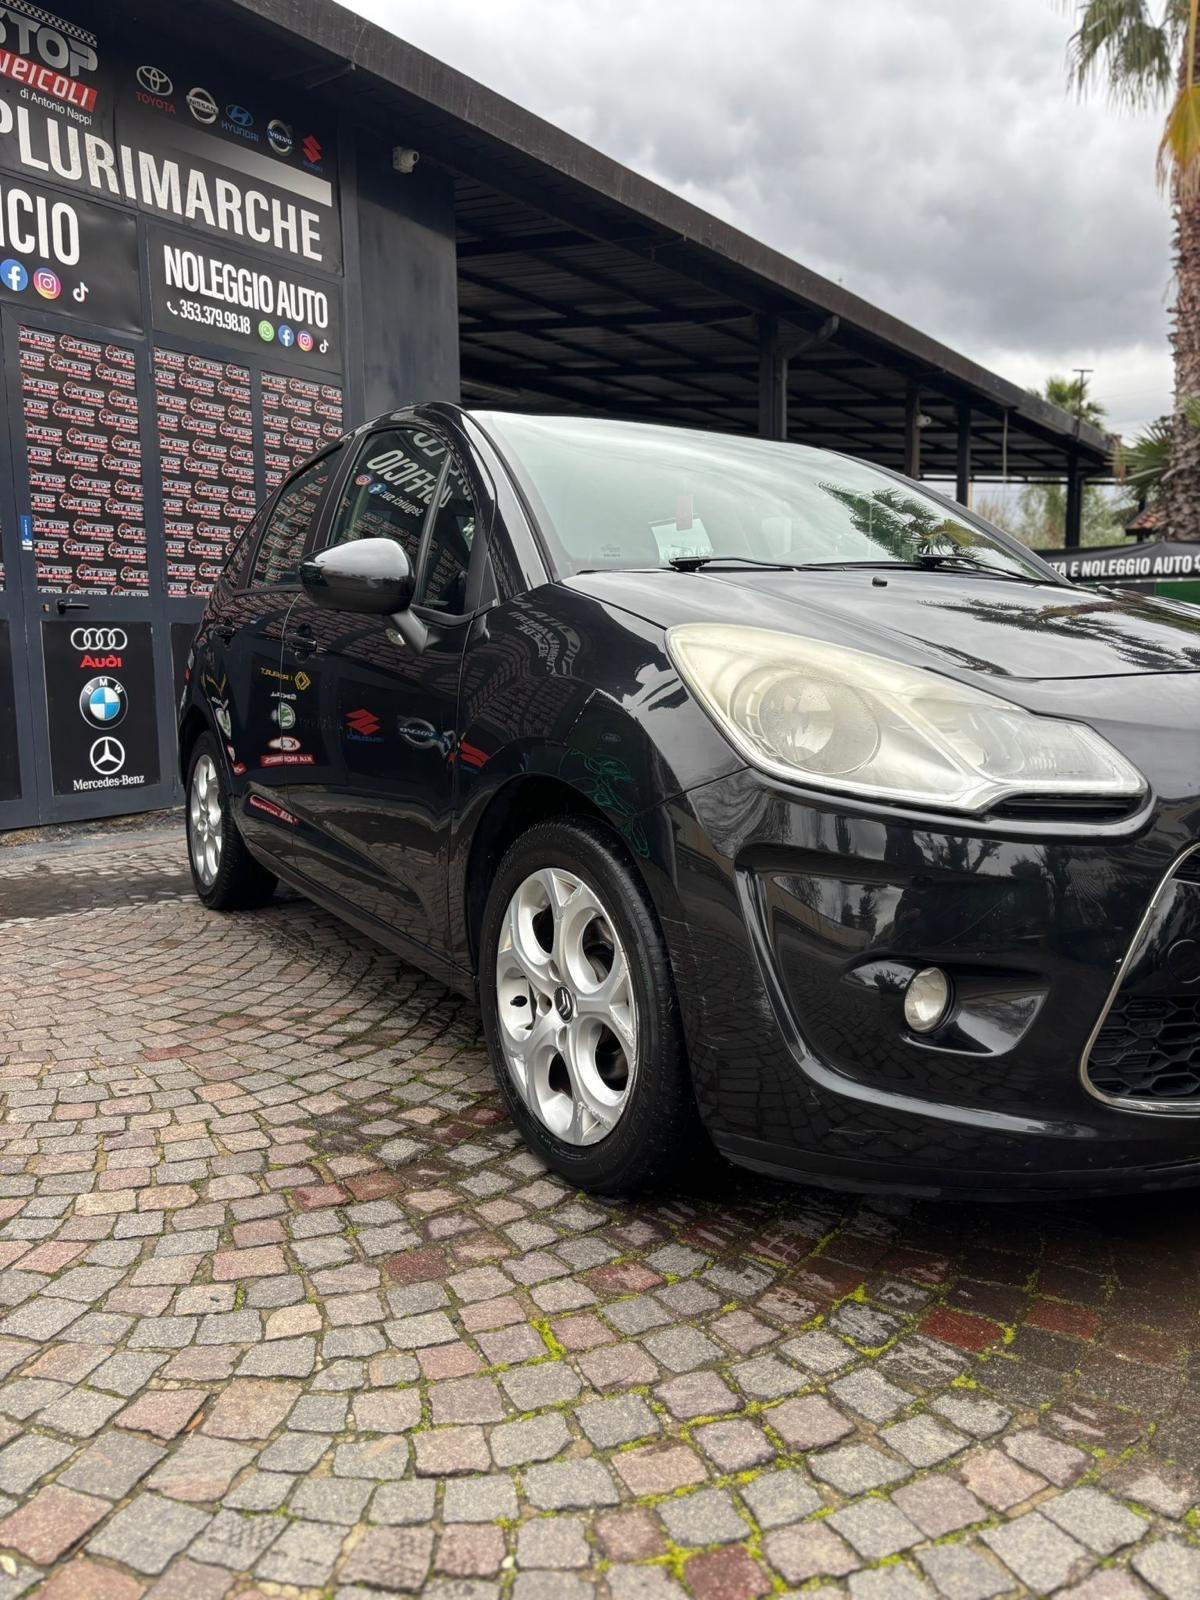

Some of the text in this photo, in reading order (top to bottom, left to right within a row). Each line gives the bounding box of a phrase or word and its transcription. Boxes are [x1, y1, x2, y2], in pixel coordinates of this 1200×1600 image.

[20, 88, 92, 125] di Antonio Nappi
[136, 91, 176, 114] TOYOTA
[188, 98, 217, 113] NISSAN
[164, 245, 329, 328] NOLEGGIO AUTO
[179, 299, 250, 335] 353.379.98.18
[1070, 561, 1079, 577] E
[1081, 557, 1151, 577] NOLEGGIO
[1152, 555, 1193, 575] AUTO
[80, 654, 122, 668] Audi
[84, 678, 123, 696] BMW
[73, 774, 145, 791] Mercedes-Benz
